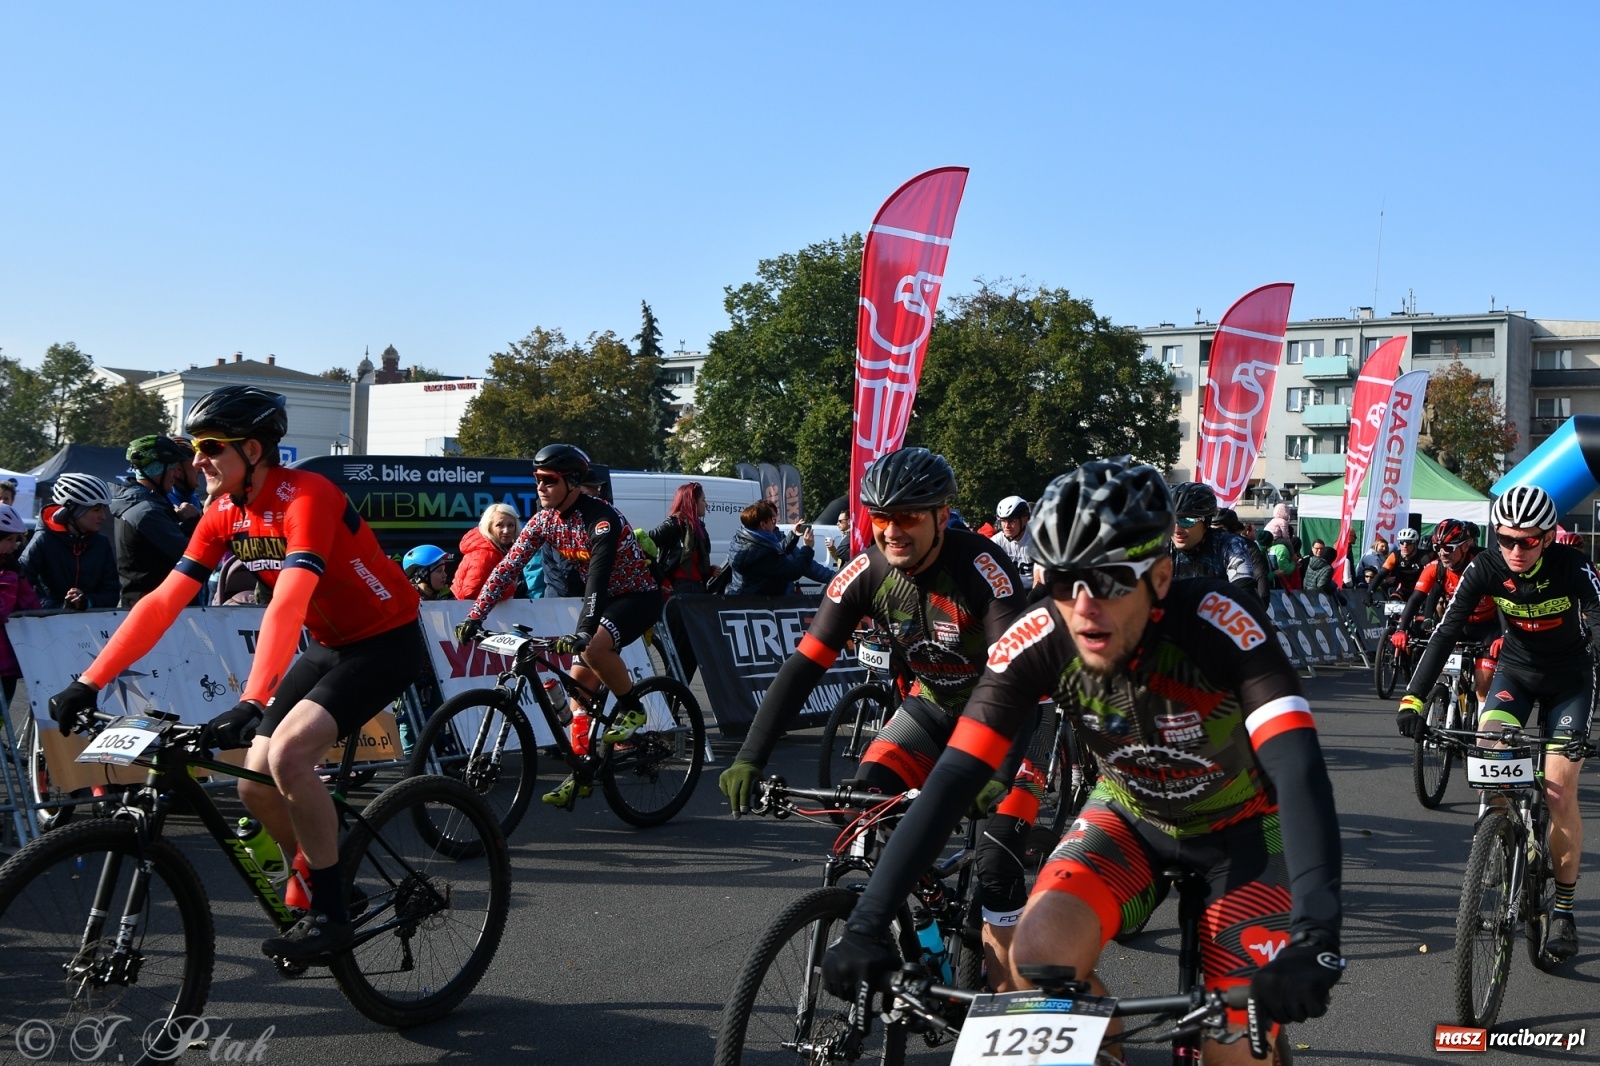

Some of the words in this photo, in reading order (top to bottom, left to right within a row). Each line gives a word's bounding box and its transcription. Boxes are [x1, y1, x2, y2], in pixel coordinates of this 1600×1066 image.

[382, 464, 421, 482] bike
[427, 465, 485, 483] atelier
[233, 537, 286, 559] BAHRAIN
[350, 558, 392, 600] MERIDA
[491, 636, 517, 645] 1806
[861, 651, 883, 665] 1860
[152, 669, 159, 679] E
[97, 735, 140, 750] 1065
[1480, 764, 1523, 777] 1546
[224, 839, 294, 922] MERIDA
[982, 1027, 1078, 1057] 1235
